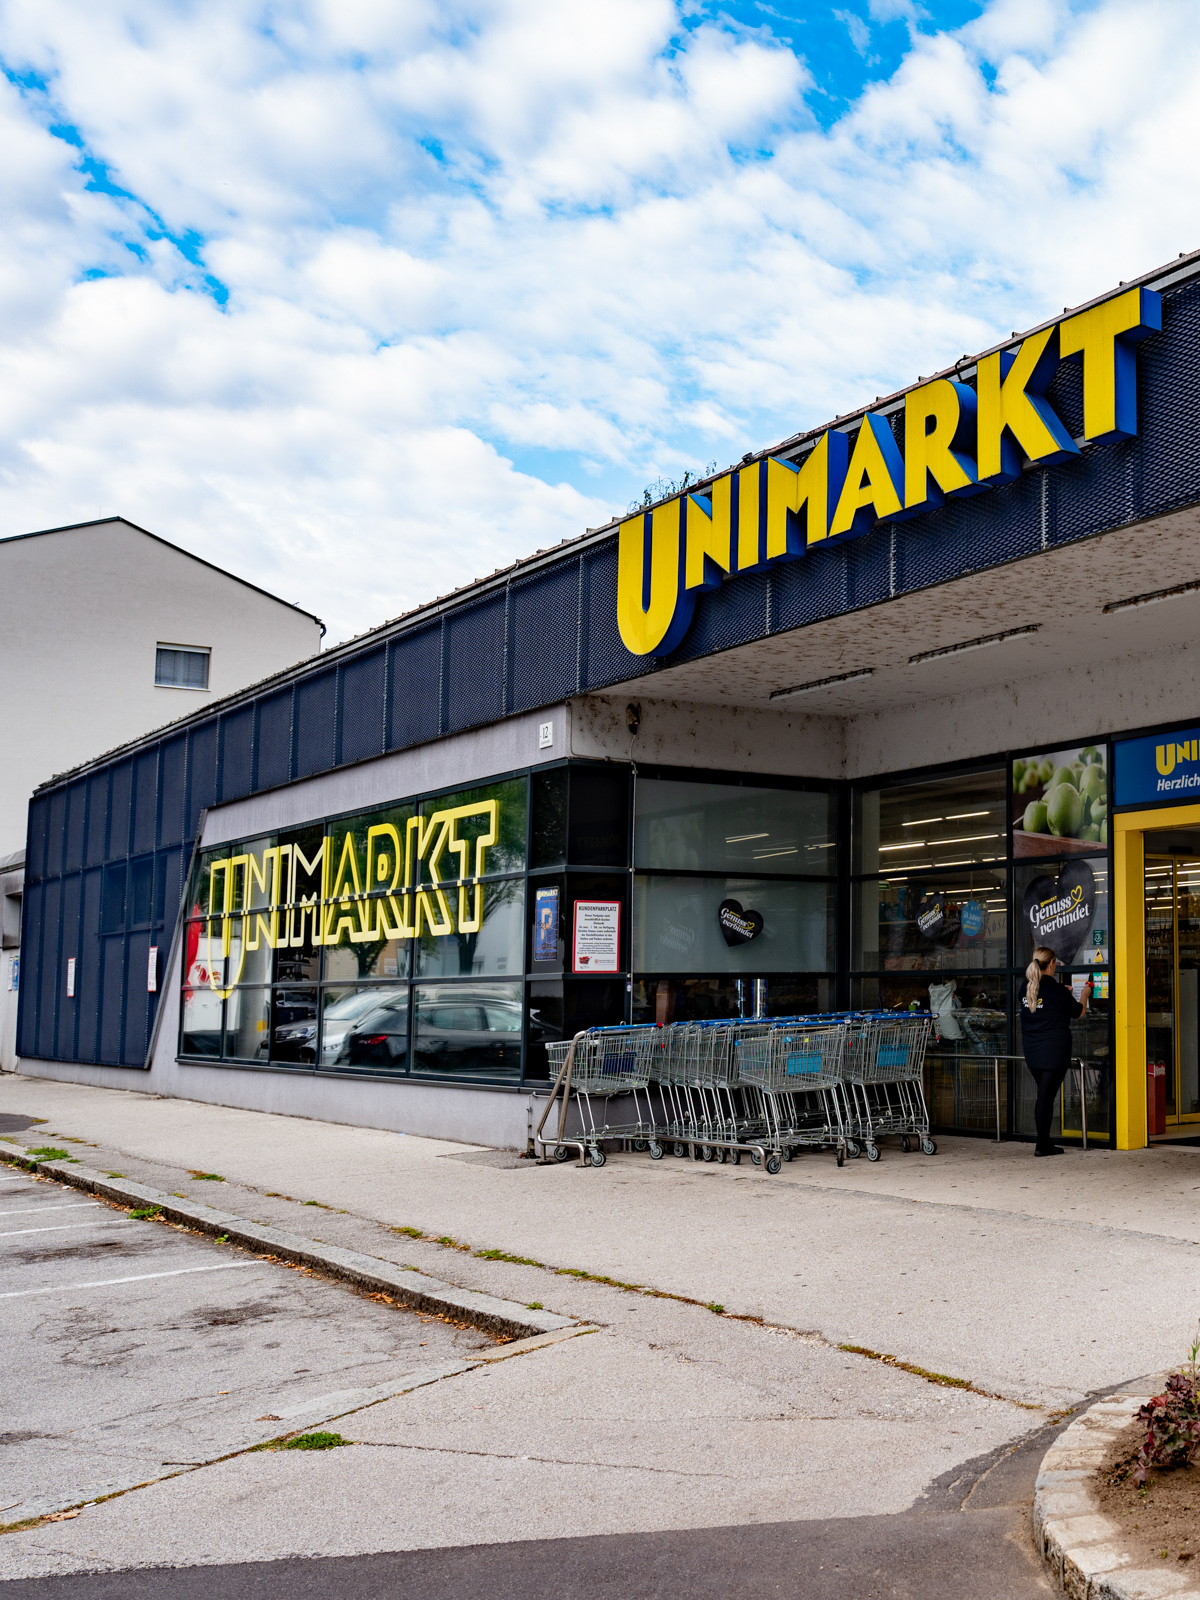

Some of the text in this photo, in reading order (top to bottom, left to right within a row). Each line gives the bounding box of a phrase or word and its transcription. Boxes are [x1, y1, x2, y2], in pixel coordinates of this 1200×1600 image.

[617, 286, 1158, 656] UNIMARKT
[1156, 773, 1200, 791] Herzlich
[207, 799, 499, 1000] UNIMARKT
[1029, 896, 1072, 929] Genuss
[541, 908, 553, 941] P
[720, 908, 748, 927] Genuss
[722, 919, 754, 939] verbindet
[917, 909, 936, 929] Genuss
[922, 911, 944, 931] verbindet
[1040, 903, 1090, 936] verbindet
